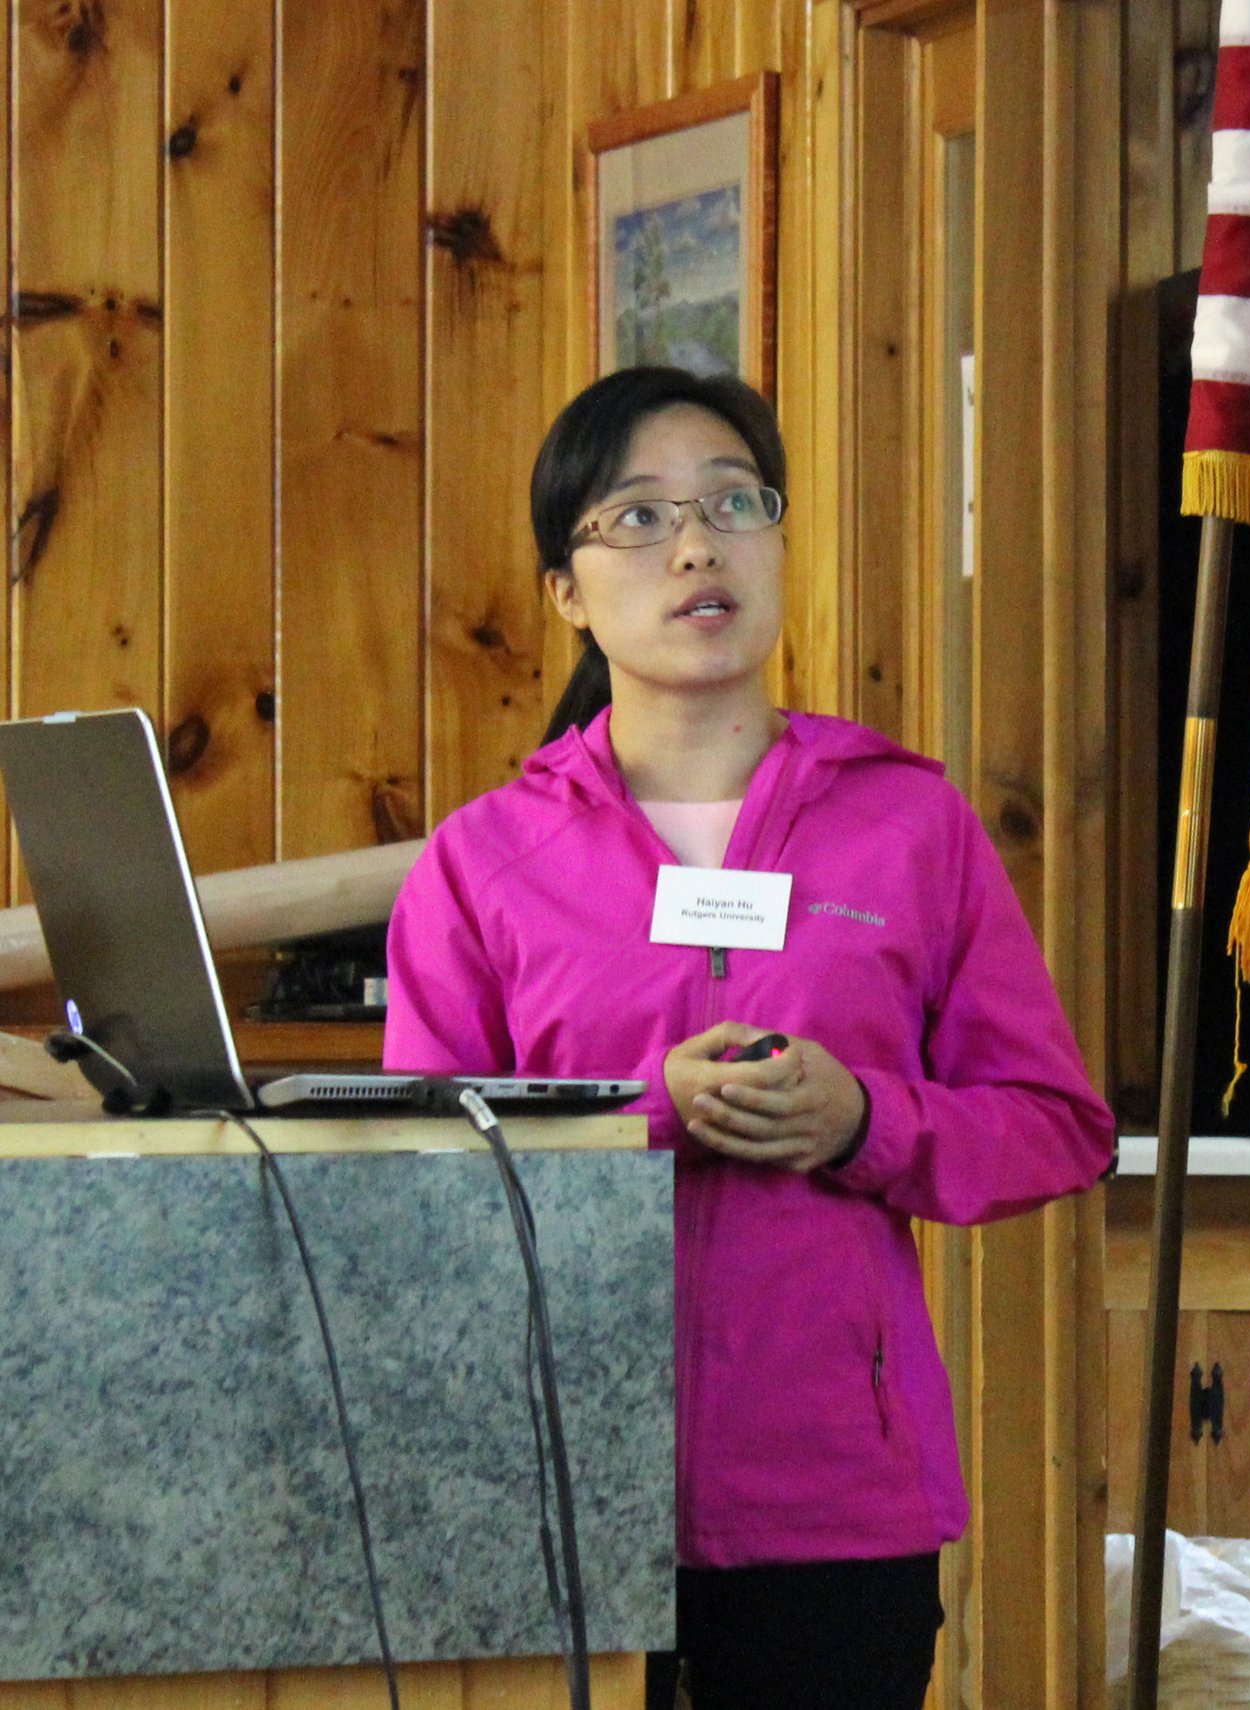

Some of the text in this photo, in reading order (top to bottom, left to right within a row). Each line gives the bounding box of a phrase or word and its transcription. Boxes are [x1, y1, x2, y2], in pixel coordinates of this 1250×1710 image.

[696, 898, 754, 910] Haiyan Hu
[681, 909, 766, 924] Rutgers University
[823, 902, 886, 927] Columbia
